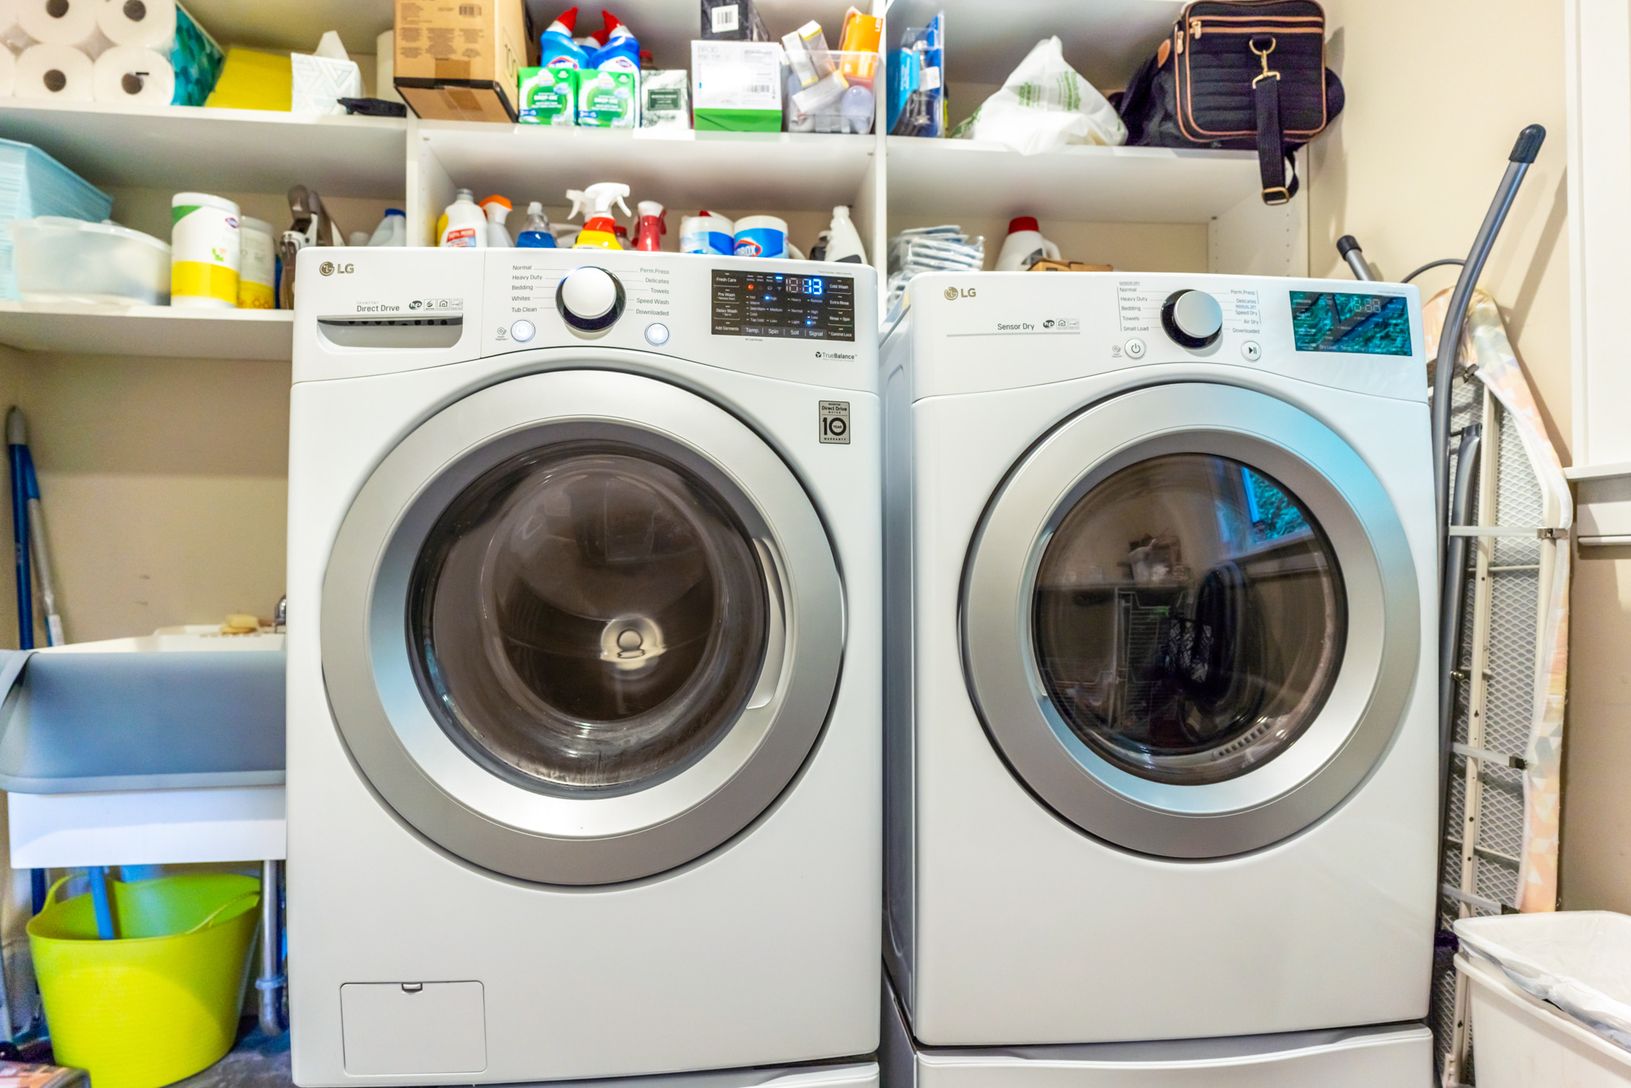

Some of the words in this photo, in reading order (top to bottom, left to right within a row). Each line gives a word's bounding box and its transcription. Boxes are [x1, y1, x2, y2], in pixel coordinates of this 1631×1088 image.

[337, 263, 355, 274] LG
[960, 288, 977, 298] LG
[636, 297, 653, 305] Speed
[380, 304, 400, 312] Drive
[635, 308, 670, 317] Downloaded
[997, 323, 1021, 331] Sensor
[1022, 322, 1035, 331] Dry
[822, 352, 855, 360] TrueBalance
[822, 417, 847, 436] 10
